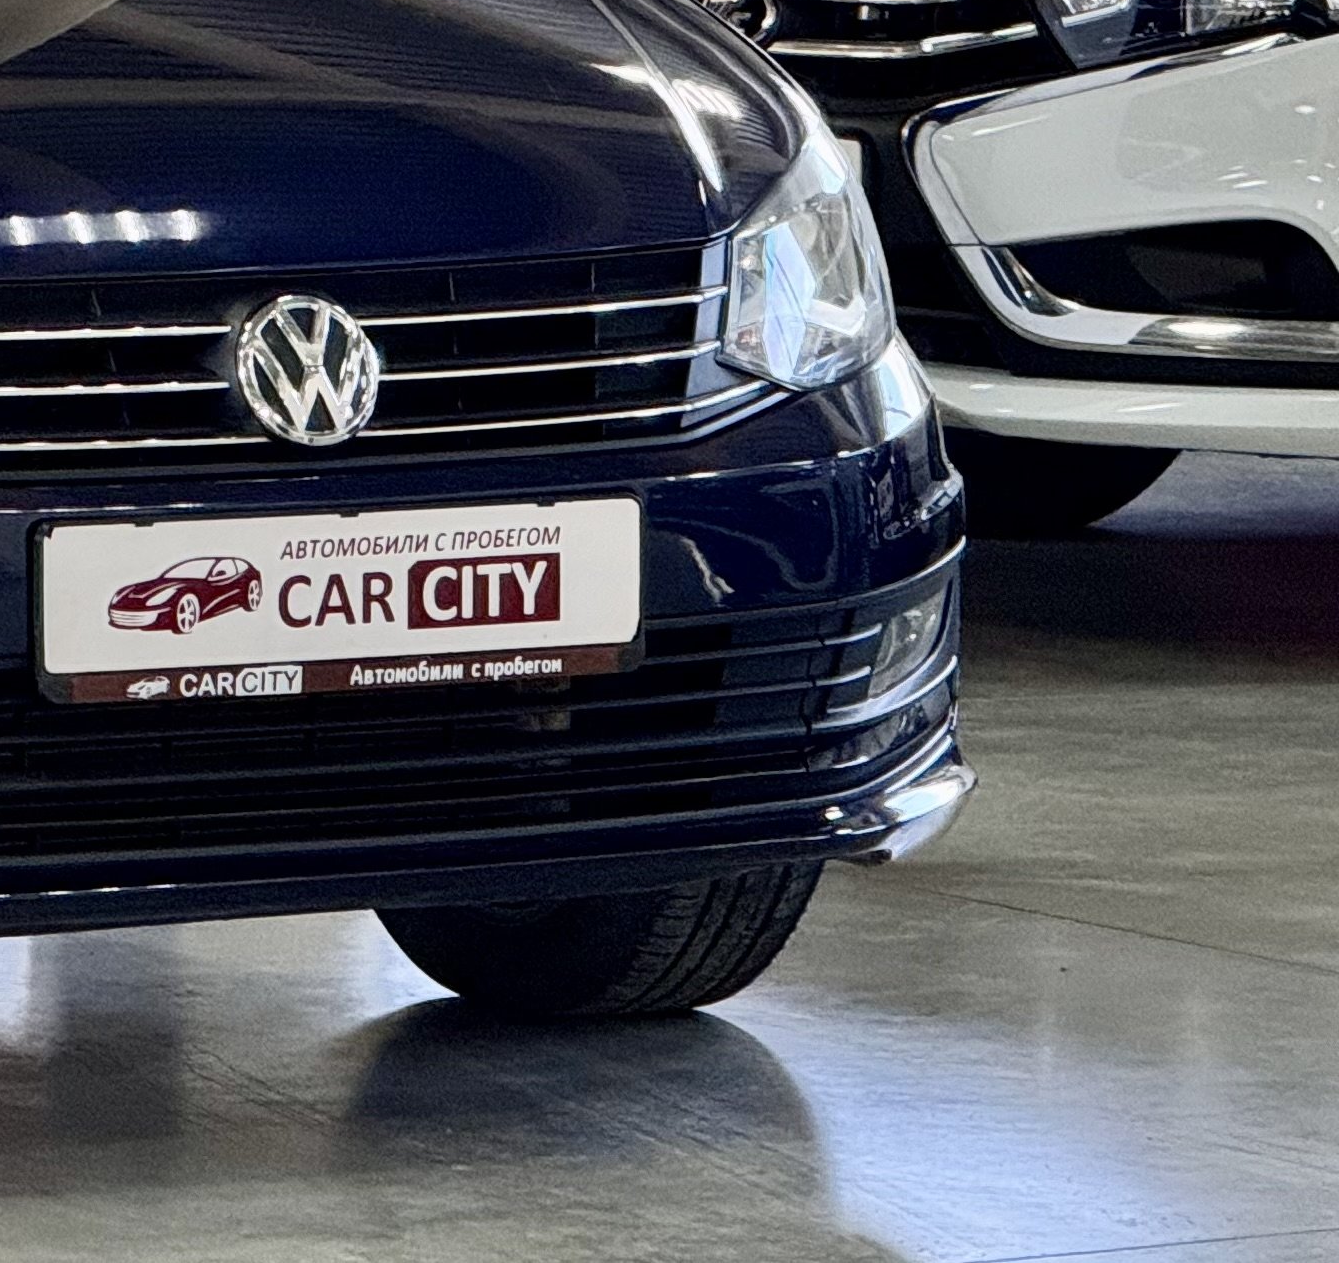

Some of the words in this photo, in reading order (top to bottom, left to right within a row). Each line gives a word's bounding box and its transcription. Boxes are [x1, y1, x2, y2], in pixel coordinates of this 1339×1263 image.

[280, 534, 429, 560] АВТОМОБИЛИ
[434, 532, 446, 552] С
[451, 526, 561, 551] ПРОБЕГОМ
[278, 571, 395, 628] CAR
[423, 560, 548, 622] CITY
[350, 660, 464, 687] Автомобили
[471, 662, 482, 678] с
[484, 655, 563, 681] пробегом
